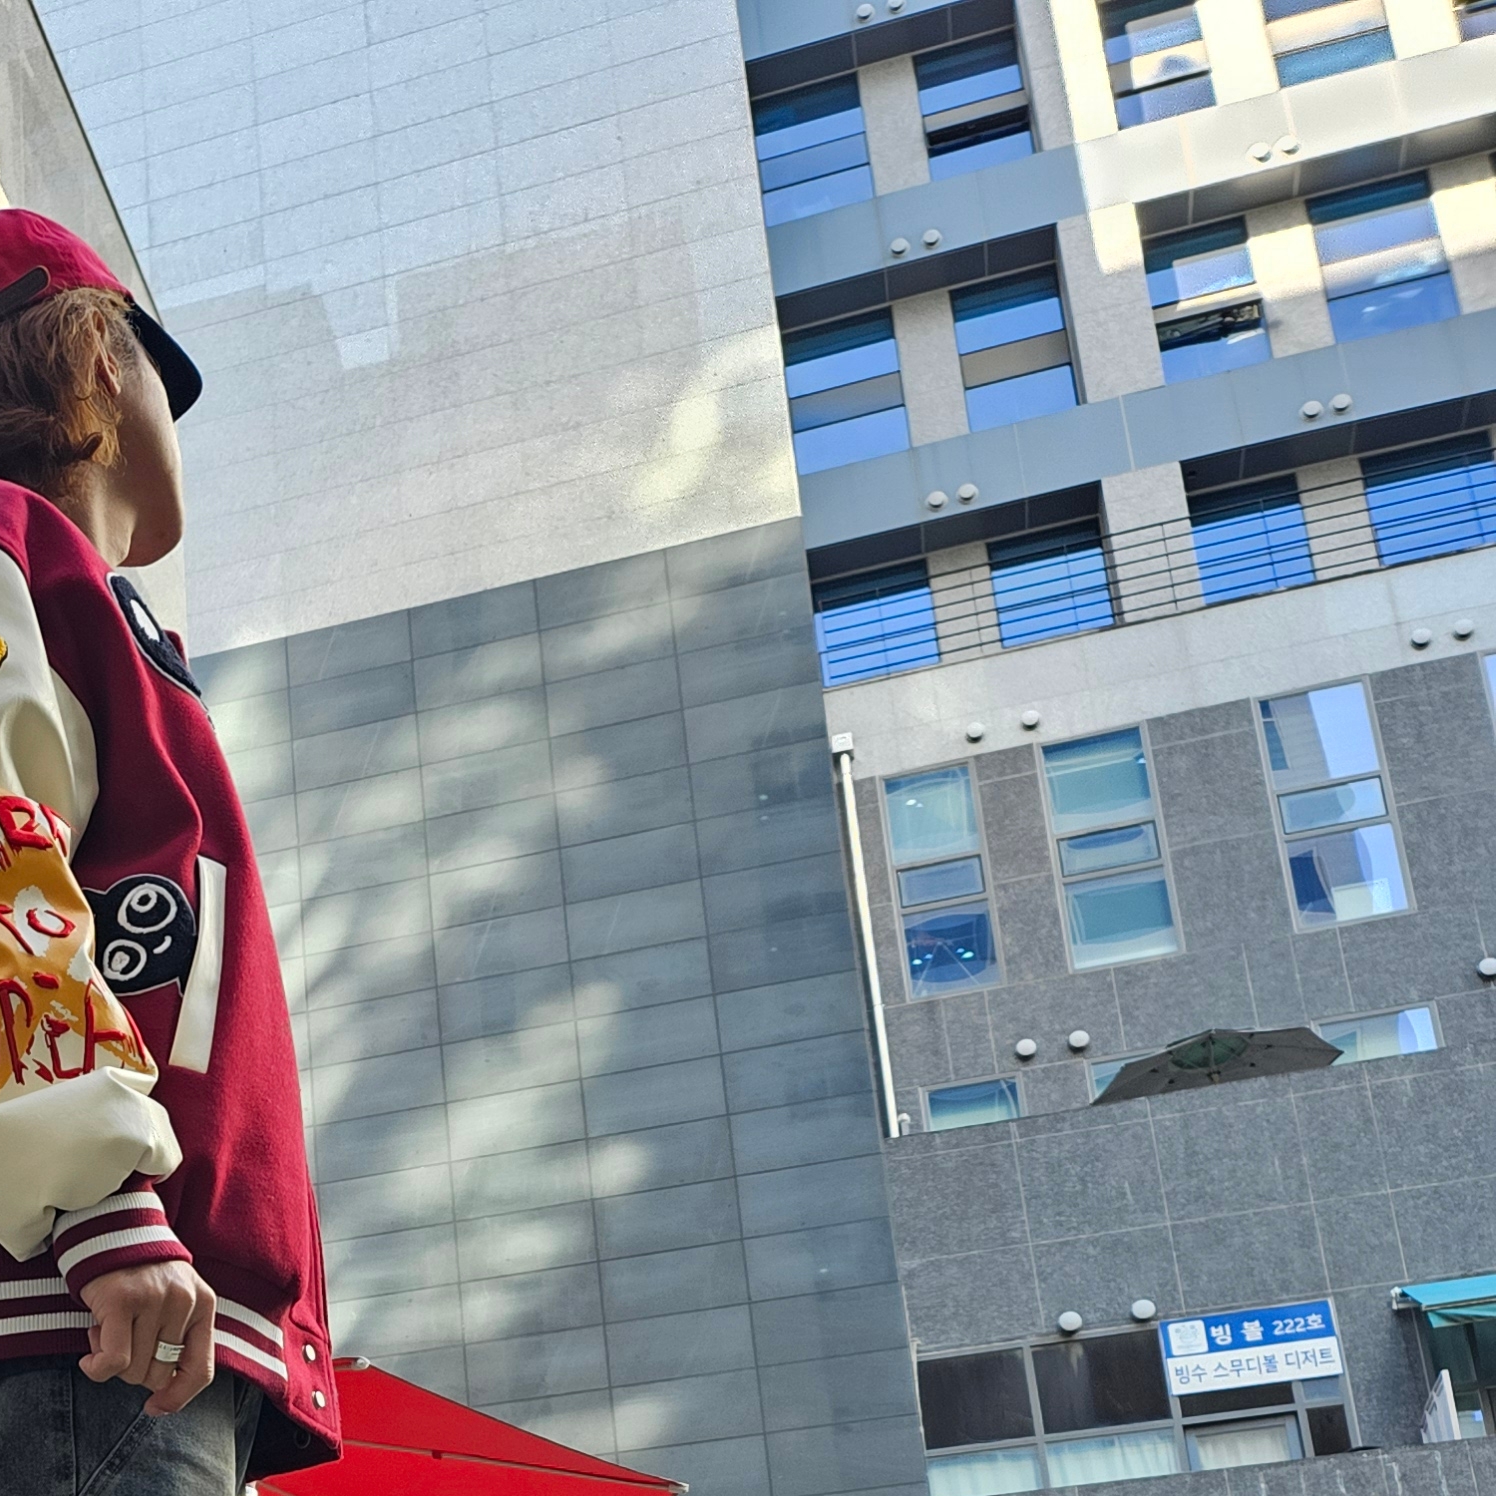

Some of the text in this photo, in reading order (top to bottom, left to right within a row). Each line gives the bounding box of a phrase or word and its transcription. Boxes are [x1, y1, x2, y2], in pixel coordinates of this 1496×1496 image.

[1210, 1313, 1326, 1346] 빙 볼 222호
[1175, 1347, 1336, 1385] 빙수 스무디볼 디저트
